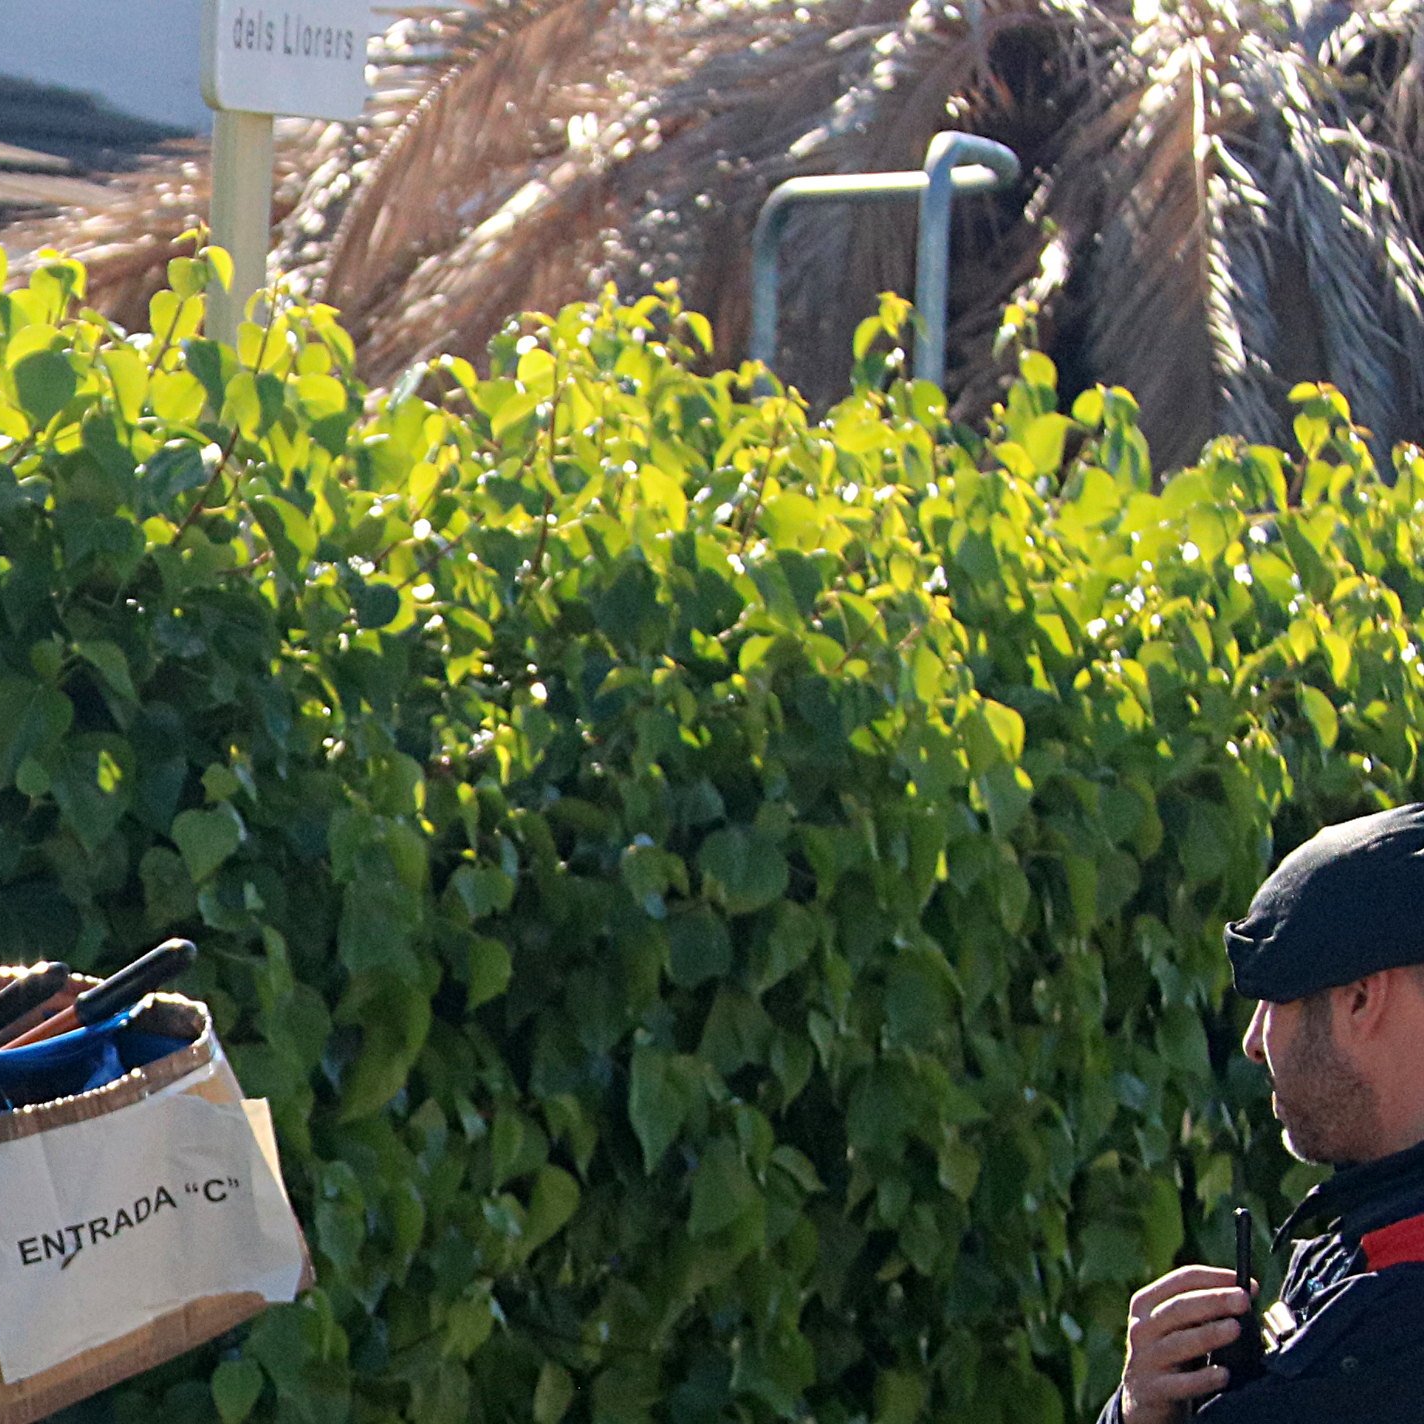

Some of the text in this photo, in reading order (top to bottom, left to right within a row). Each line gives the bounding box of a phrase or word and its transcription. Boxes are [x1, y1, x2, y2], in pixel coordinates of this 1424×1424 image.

[233, 7, 353, 60] dels Llorers
[17, 1185, 177, 1269] ENTRADA
